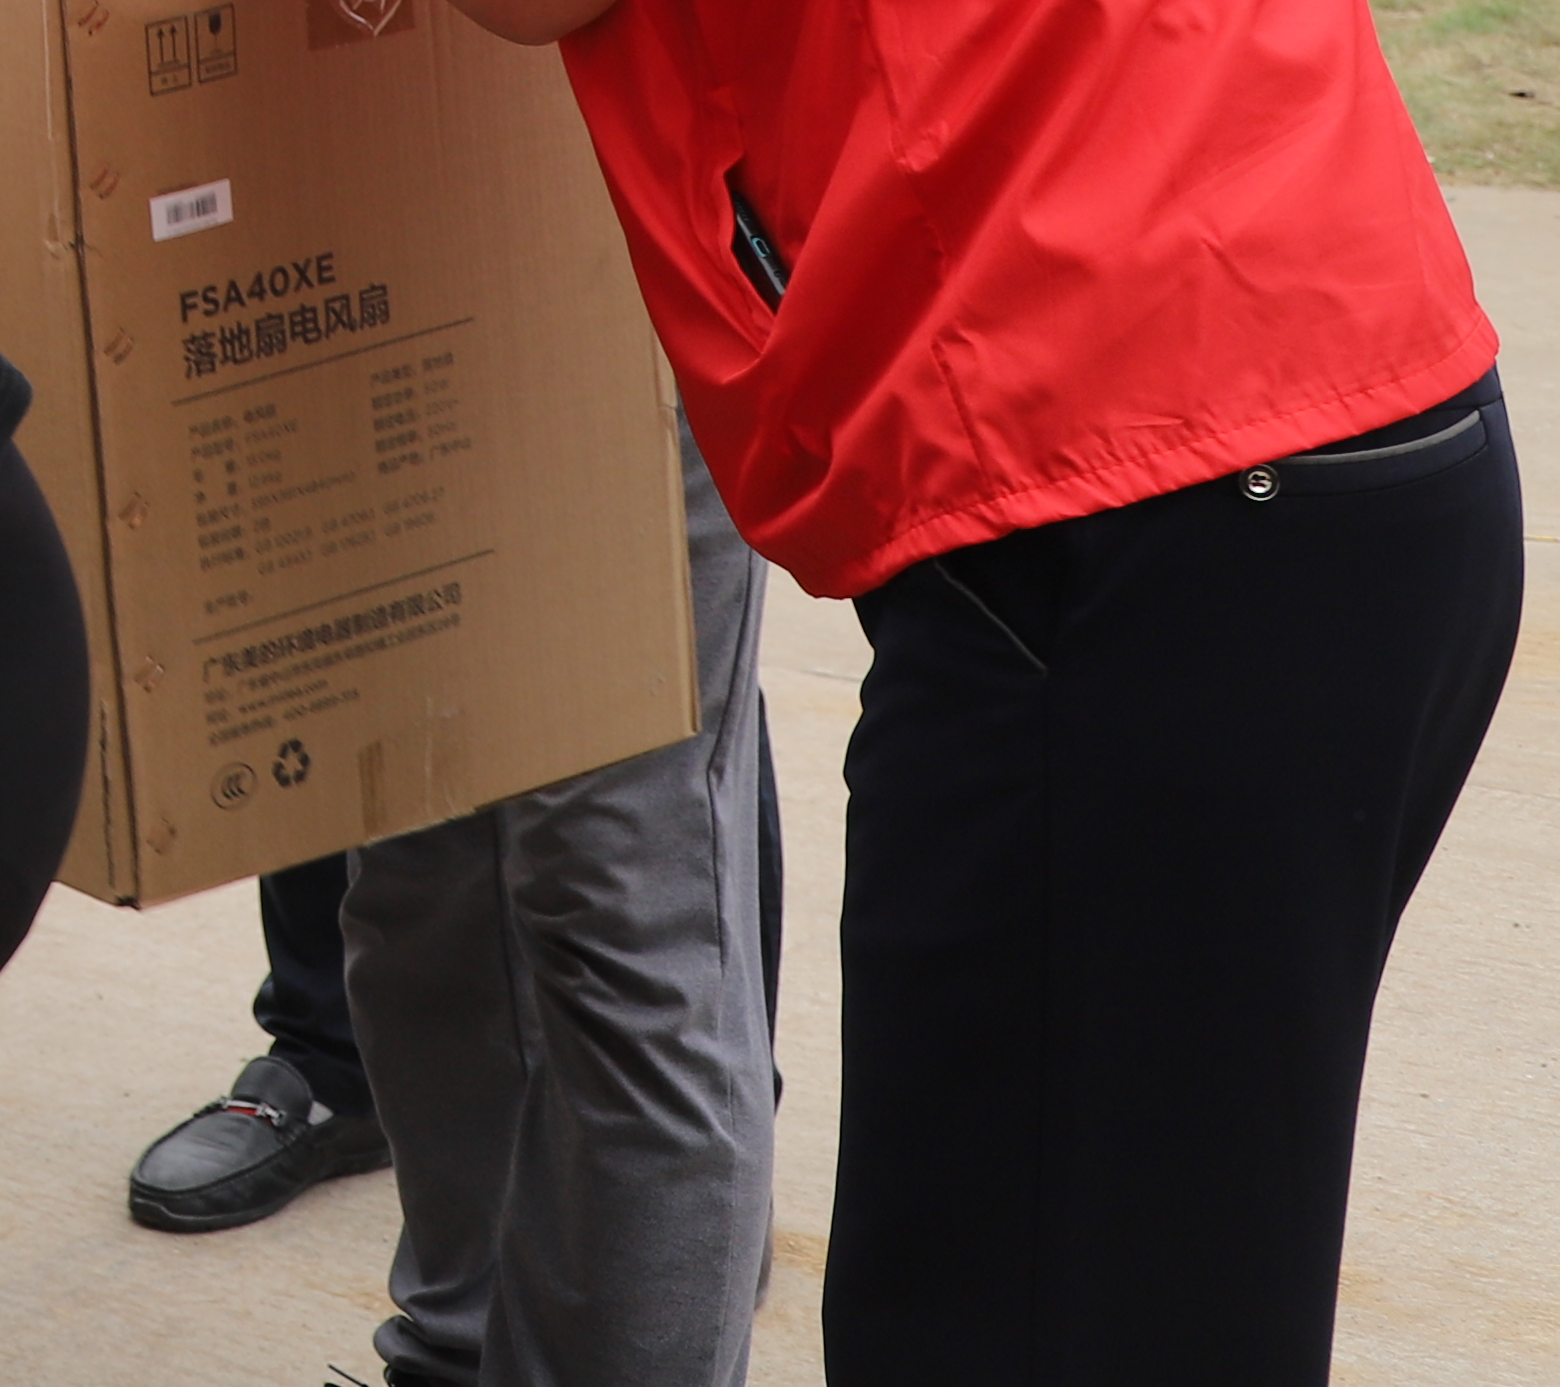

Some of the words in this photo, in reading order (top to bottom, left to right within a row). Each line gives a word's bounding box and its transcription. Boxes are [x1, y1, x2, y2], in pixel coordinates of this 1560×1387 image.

[178, 251, 337, 324] FSA40XE
[181, 282, 391, 380] 落地扇电风扇
